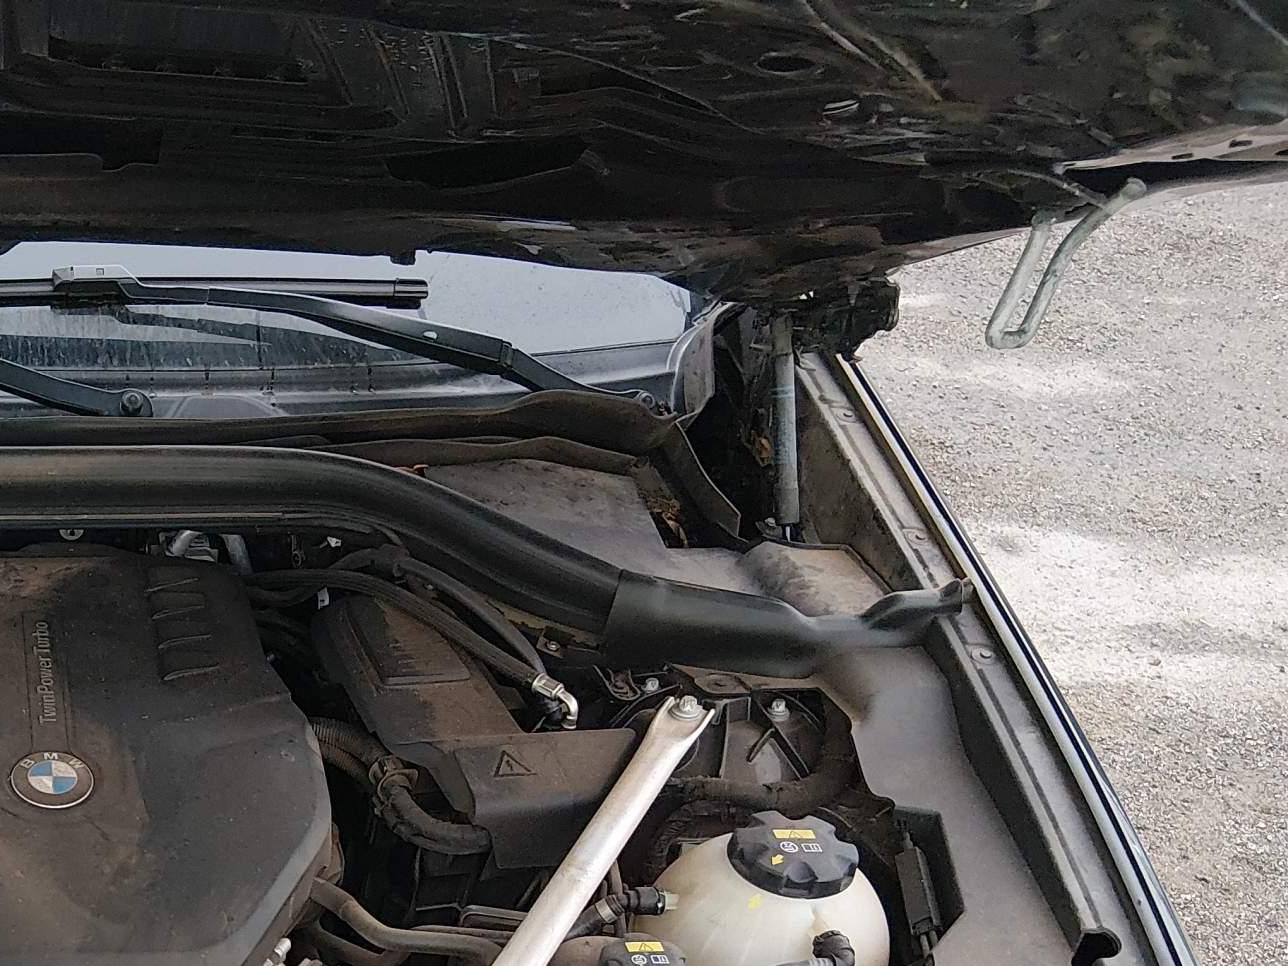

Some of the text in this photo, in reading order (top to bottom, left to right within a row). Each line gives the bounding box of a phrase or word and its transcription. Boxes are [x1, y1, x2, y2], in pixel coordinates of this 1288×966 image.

[32, 621, 57, 724] TwinPower Turbo
[20, 752, 85, 769] BMW
